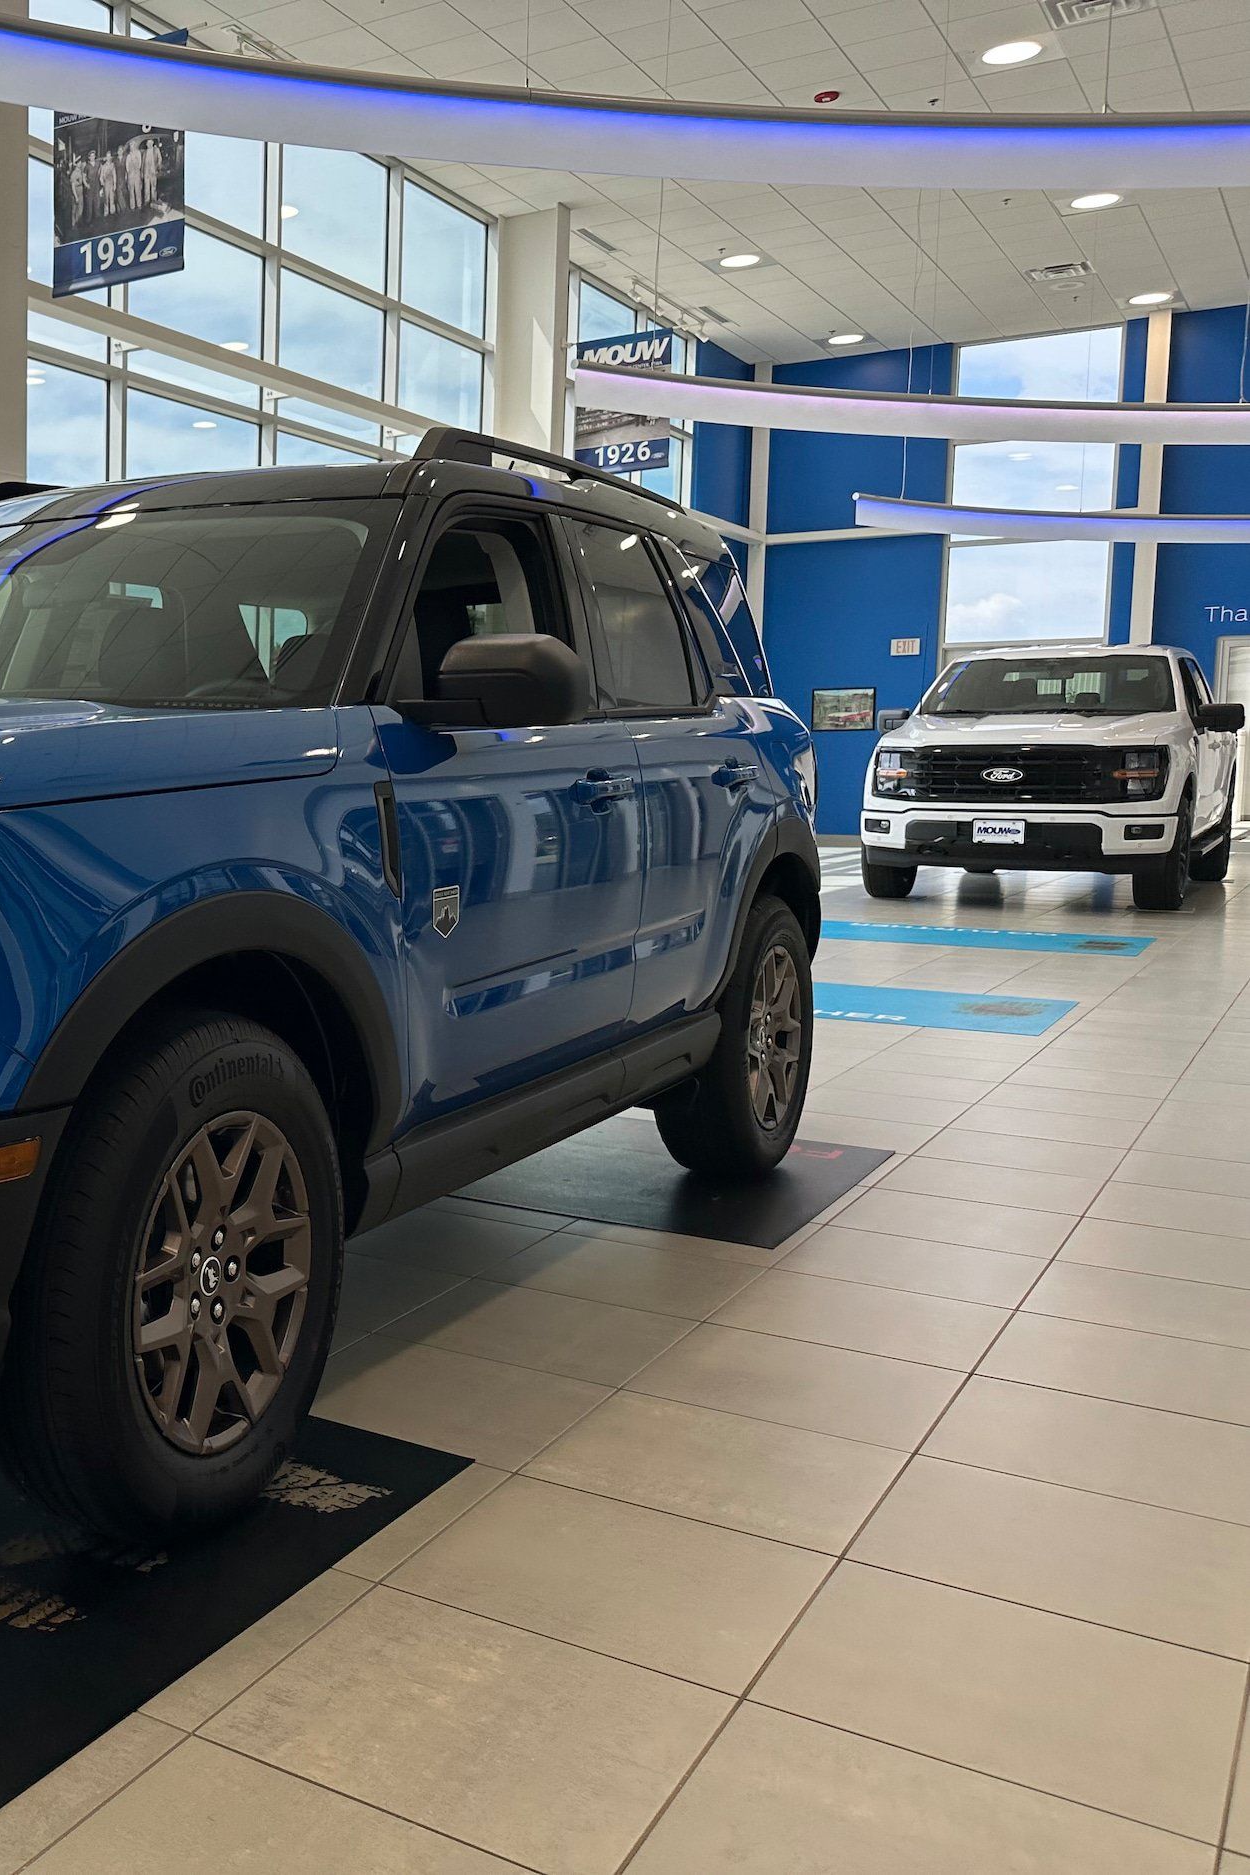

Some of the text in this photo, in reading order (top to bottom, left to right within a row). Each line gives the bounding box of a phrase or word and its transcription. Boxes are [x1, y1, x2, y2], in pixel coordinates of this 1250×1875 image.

[80, 228, 158, 274] 1932
[582, 337, 670, 366] MOUW
[594, 441, 651, 467] 1926
[1204, 605, 1248, 622] Tha
[896, 640, 916, 654] EXIT
[990, 769, 1017, 780] Ford
[977, 826, 1010, 835] MOUW
[189, 1053, 274, 1108] Continental
